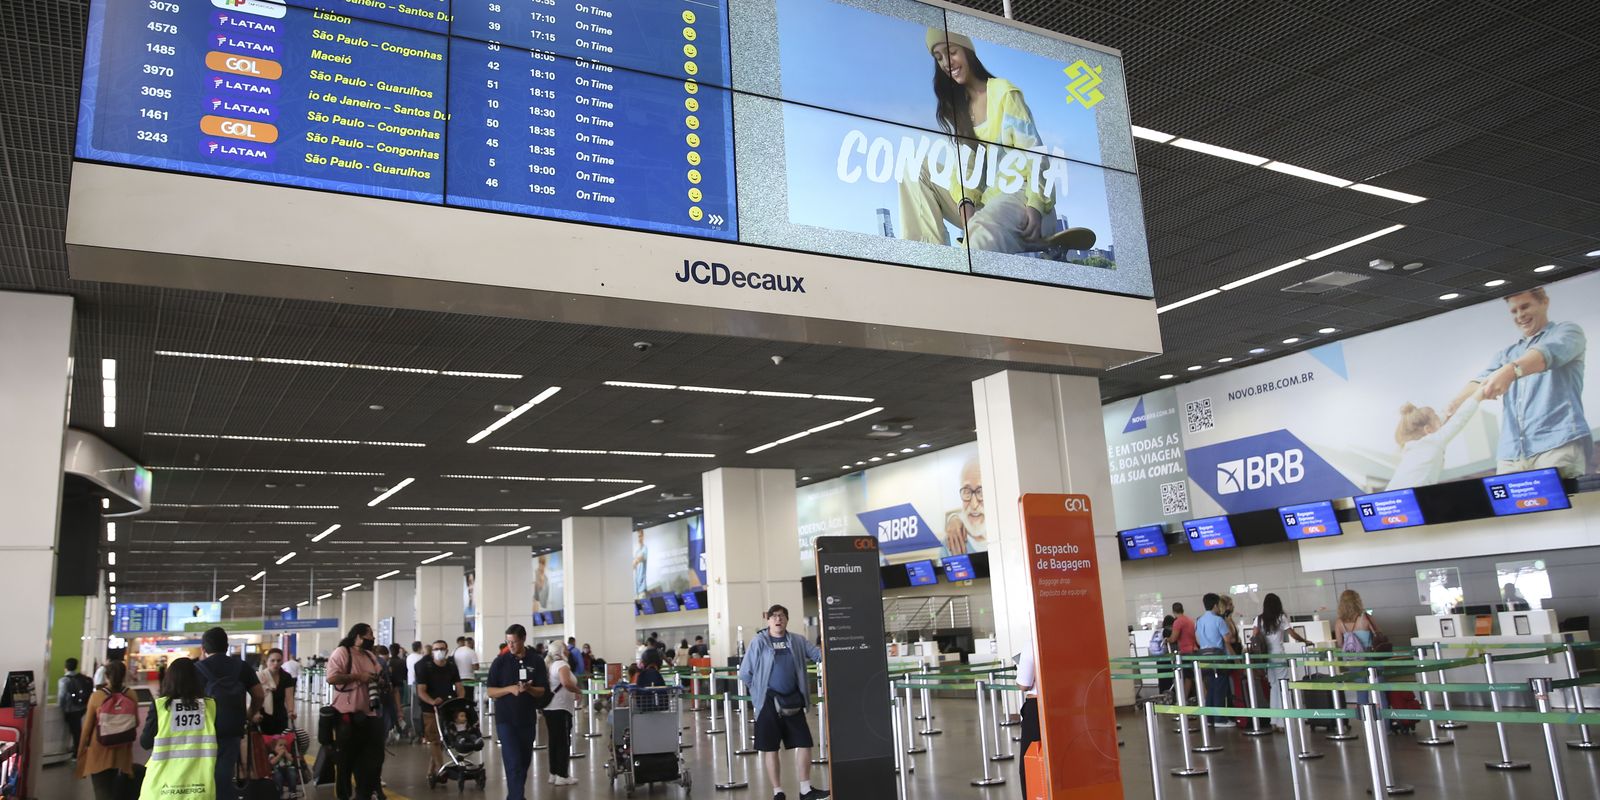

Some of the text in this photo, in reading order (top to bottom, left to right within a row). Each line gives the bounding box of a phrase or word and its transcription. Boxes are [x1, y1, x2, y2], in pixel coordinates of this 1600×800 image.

[150, 0, 180, 13] 3079
[398, 4, 434, 18] Santos
[488, 4, 500, 13] 38
[576, 4, 612, 18] On Time
[313, 8, 352, 24] Lisbon
[531, 12, 556, 24] 17:10
[147, 21, 178, 34] 4578
[231, 18, 276, 32] LATAM
[488, 22, 500, 31] 39
[576, 21, 612, 36] On Time
[531, 30, 556, 41] 17:15
[146, 42, 176, 56] 1485
[229, 39, 274, 53] LATAM
[312, 29, 334, 41] São
[337, 34, 368, 48] Paulo
[381, 42, 443, 60] Congonhas
[488, 41, 500, 51] 30
[576, 39, 613, 53] On Time
[311, 49, 352, 64] Maceió
[530, 48, 556, 62] 18:05
[143, 64, 174, 77] 3970
[225, 57, 260, 74] GOL
[488, 61, 500, 70] 42
[576, 57, 613, 72] On Time
[530, 69, 555, 80] 18:10
[226, 80, 271, 95] LATAM
[310, 70, 332, 82] São
[334, 74, 366, 87] Paulo
[376, 81, 433, 98] Guarulhos
[487, 80, 499, 89] 51
[576, 76, 613, 91] On Time
[141, 86, 172, 99] 3095
[530, 88, 555, 99] 18:15
[224, 101, 270, 115] LATAM
[308, 92, 320, 100] io
[322, 94, 337, 102] de
[340, 96, 381, 110] Janeiro
[394, 104, 431, 118] Santos
[488, 100, 499, 109] 10
[576, 95, 614, 110] On Time
[140, 108, 169, 121] 1461
[529, 106, 555, 118] 18:30
[307, 111, 329, 122] São
[332, 115, 365, 128] Paulo
[377, 122, 441, 140] Congonhas
[487, 119, 499, 128] 50
[576, 113, 614, 128] On Time
[136, 130, 168, 143] 3243
[220, 121, 256, 138] GOL
[529, 126, 555, 137] 18:35
[306, 132, 328, 144] São
[330, 136, 364, 149] Paulo
[376, 142, 440, 160] Congonhas
[486, 139, 499, 148] 45
[576, 133, 614, 147] On Time
[221, 144, 267, 159] LATAM
[529, 145, 555, 156] 18:35
[304, 153, 327, 165] São
[330, 157, 363, 170] Paulo
[373, 163, 431, 179] Guarulhos
[489, 159, 496, 167] 5
[576, 152, 614, 166] On Time
[836, 130, 1068, 198] CONQUISTA
[529, 165, 555, 176] 19:00
[576, 171, 615, 184] On Time
[485, 178, 498, 188] 46
[529, 184, 555, 195] 19:05
[576, 190, 615, 203] On Time
[675, 260, 806, 294] JCDecaux
[1228, 372, 1314, 401] NOVO.BRB.COM.BR
[1116, 444, 1130, 456] EM
[1130, 436, 1163, 453] TODAS
[1166, 433, 1179, 445] AS
[1119, 457, 1139, 469] BOA
[1141, 447, 1181, 464] VIAGEM
[1128, 468, 1146, 482] SUA
[1148, 462, 1183, 478] CONTA.
[1246, 448, 1304, 490] BRB
[1494, 490, 1506, 498] 52
[1065, 498, 1089, 512] GOL
[891, 515, 918, 540] BRB
[855, 539, 876, 550] GOL
[1035, 543, 1078, 556] Despacho
[824, 564, 862, 574] Premium
[1037, 559, 1091, 571] de Bagagem
[175, 714, 200, 726] 1973
